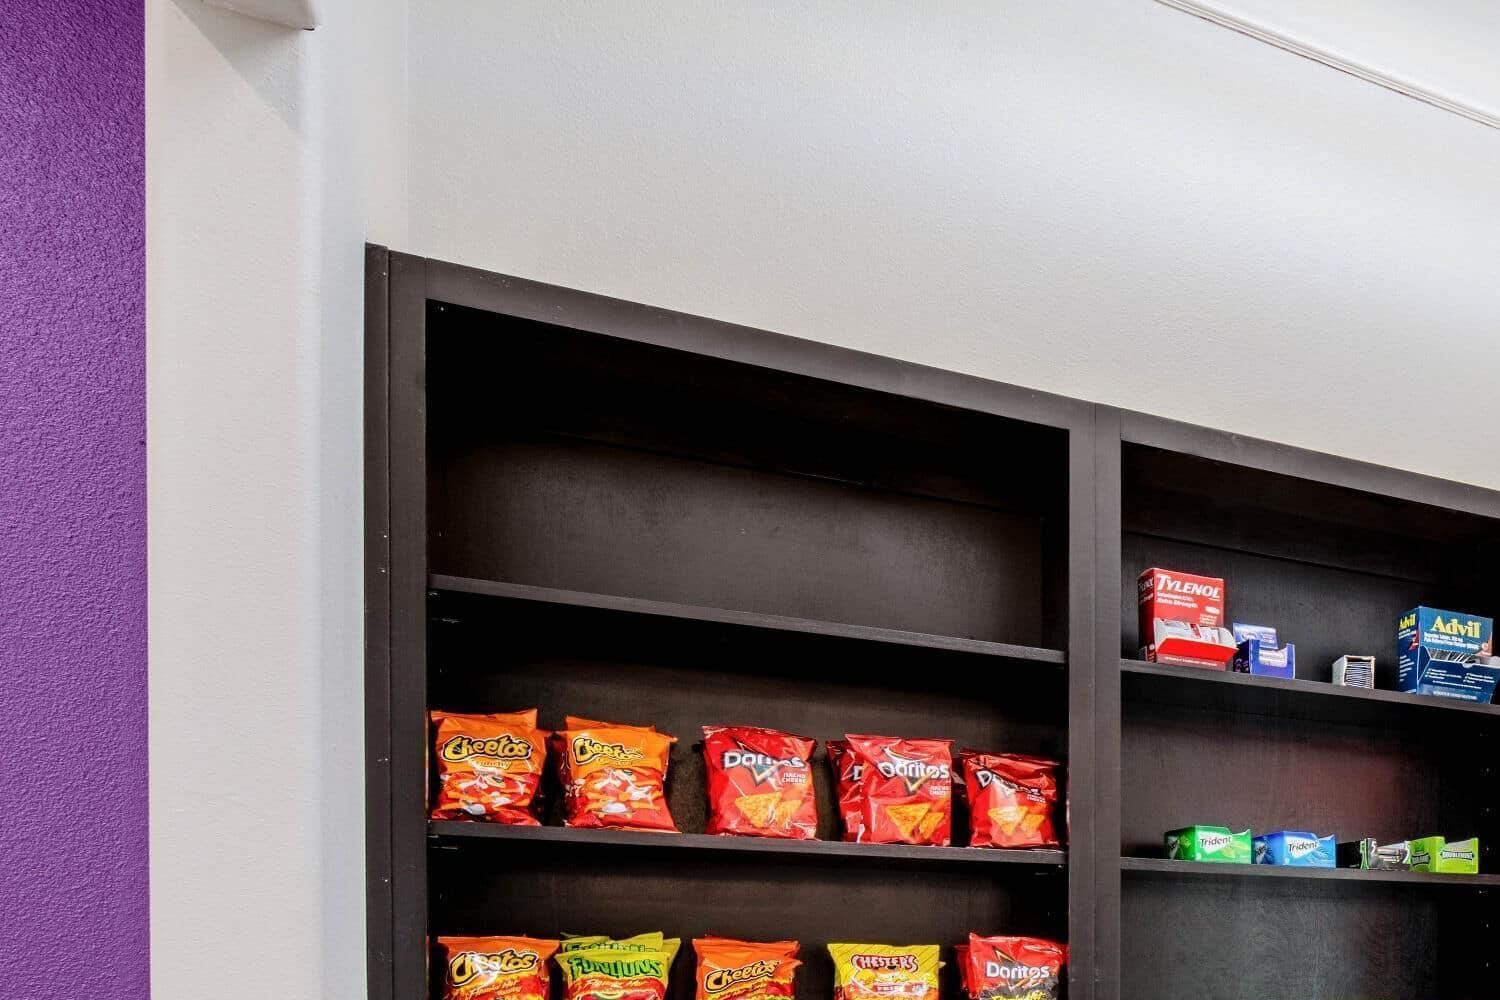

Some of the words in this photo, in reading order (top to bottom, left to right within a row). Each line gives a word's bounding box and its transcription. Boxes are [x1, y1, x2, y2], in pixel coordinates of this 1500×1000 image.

[1157, 573, 1221, 599] TYLENOL
[1431, 615, 1482, 638] Advil
[442, 736, 529, 761] Cheetos
[573, 737, 643, 763] Cheetos
[879, 761, 950, 779] Doritos
[1199, 835, 1233, 848] Trident
[1287, 840, 1319, 852] Trident
[451, 949, 537, 987] Cheetos
[852, 954, 919, 973] CHESTER'S
[986, 961, 1050, 978] Doritos
[704, 960, 779, 992] Cheetos
